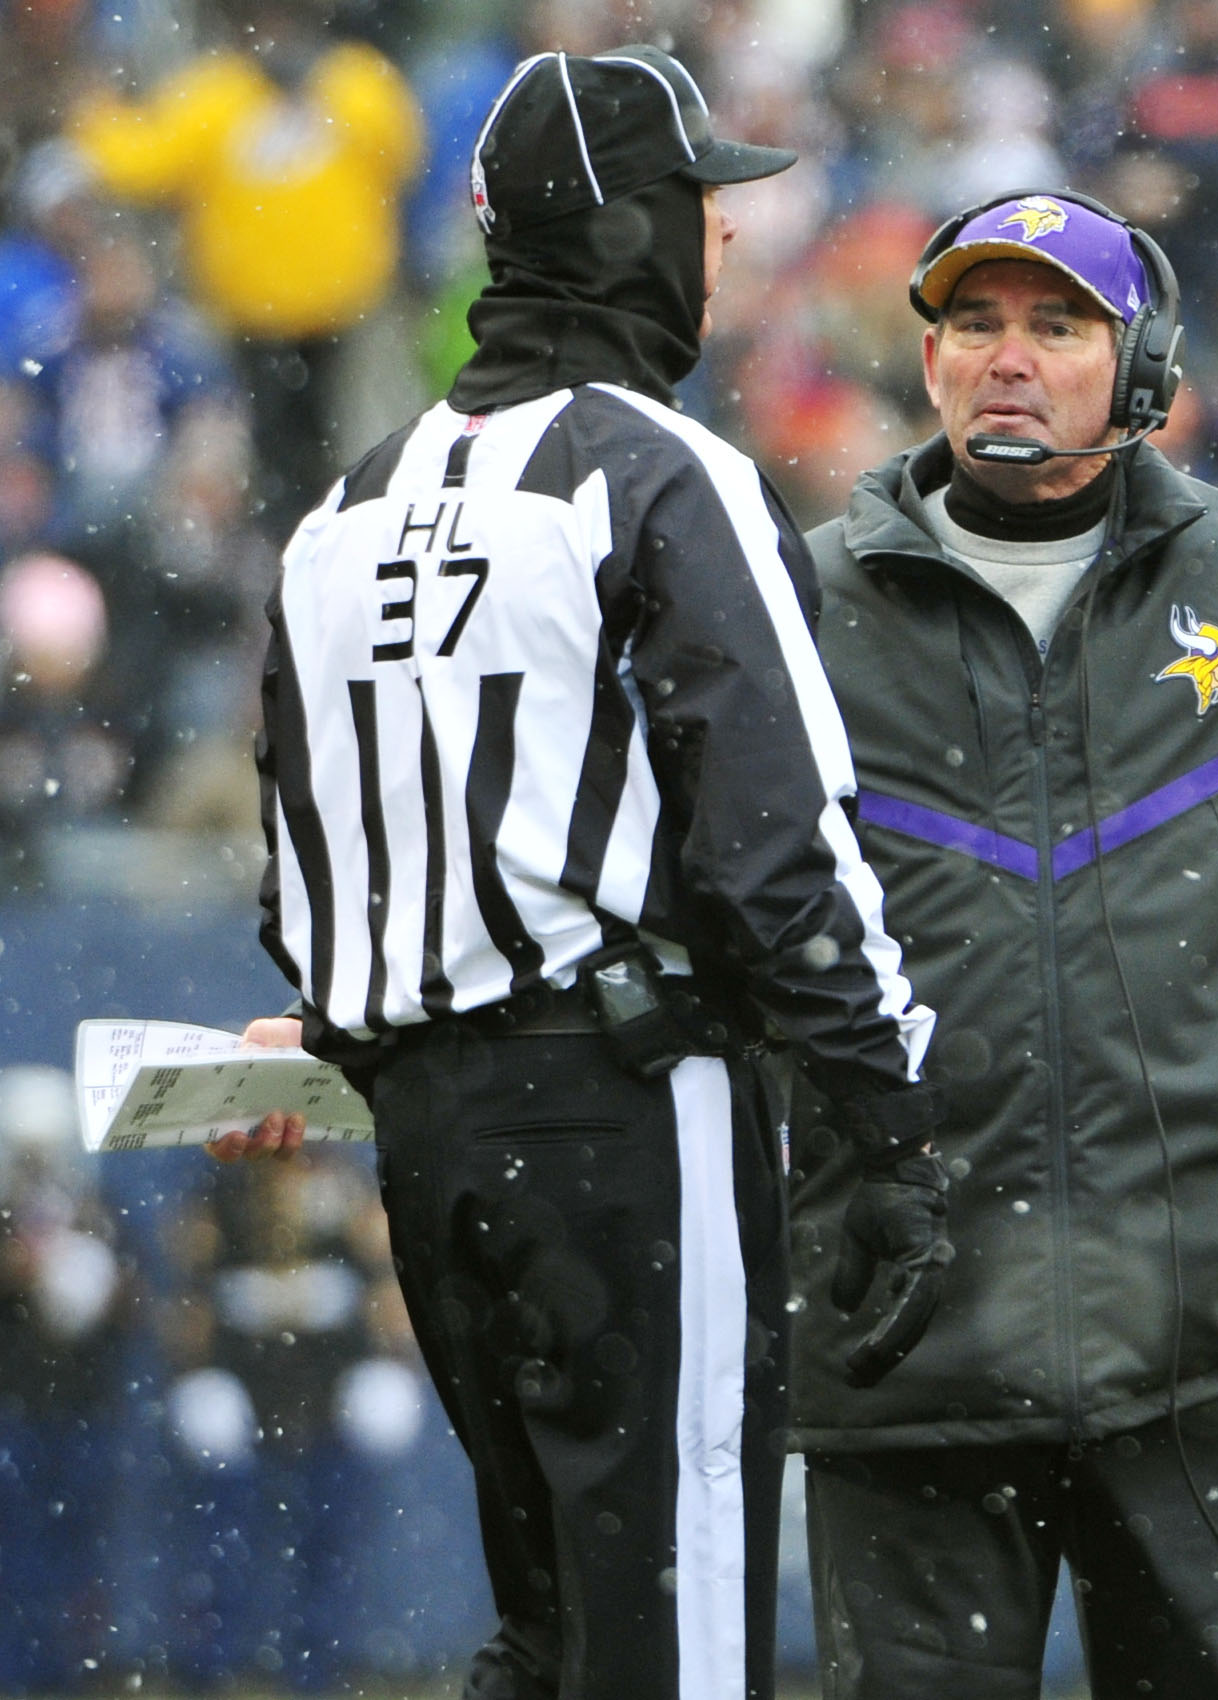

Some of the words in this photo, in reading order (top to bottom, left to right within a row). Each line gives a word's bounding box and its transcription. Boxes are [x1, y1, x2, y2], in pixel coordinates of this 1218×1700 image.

[976, 444, 1041, 458] BOSE
[397, 501, 472, 556] HL
[372, 557, 489, 662] 37
